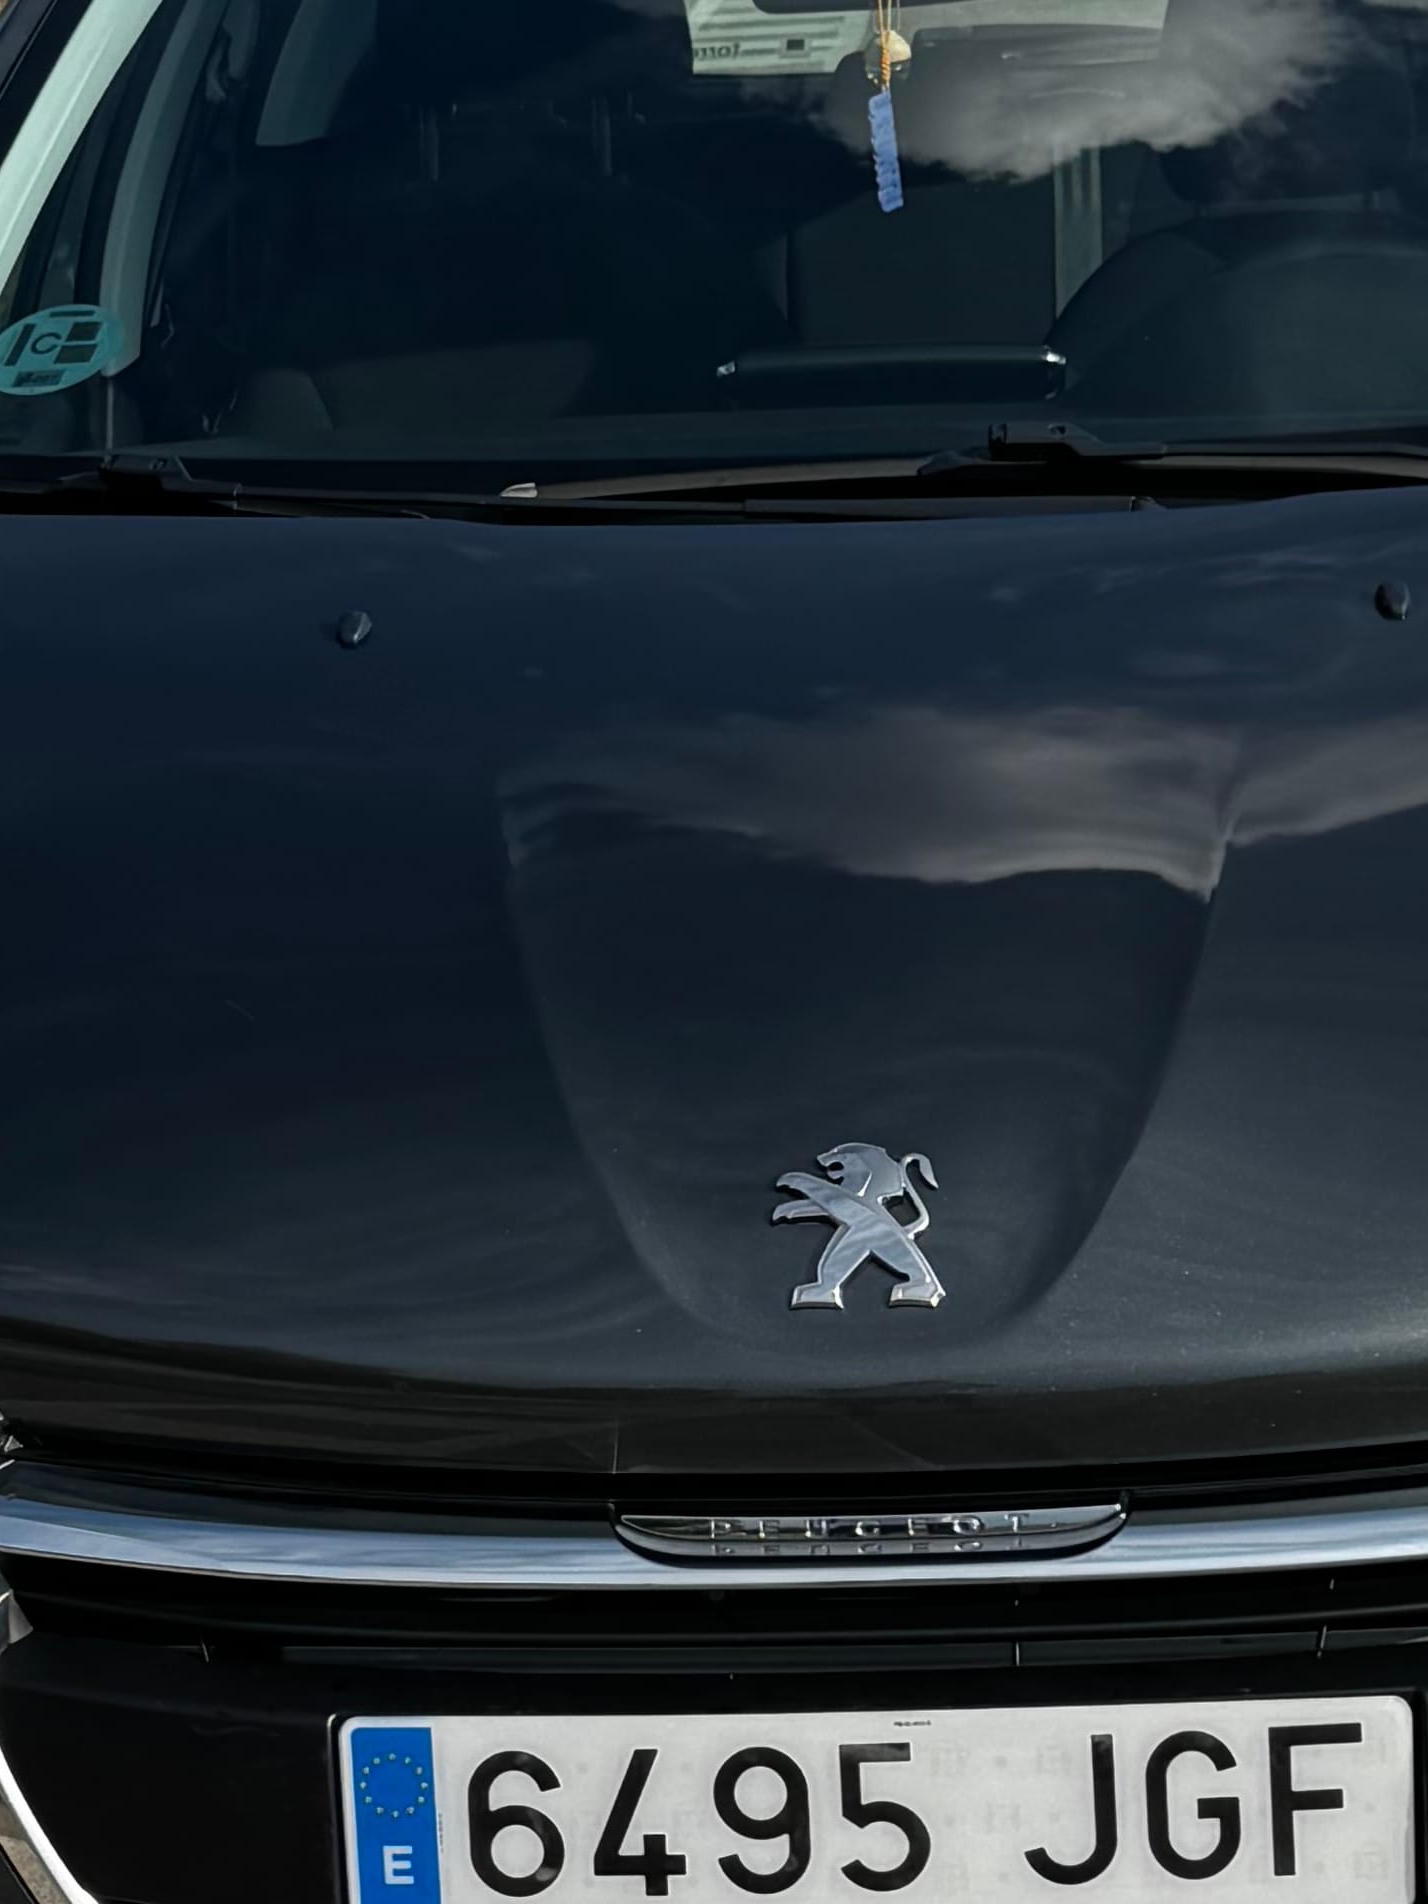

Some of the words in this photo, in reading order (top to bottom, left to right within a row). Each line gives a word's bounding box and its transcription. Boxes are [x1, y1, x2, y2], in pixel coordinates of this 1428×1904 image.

[30, 332, 62, 355] C
[710, 1512, 1029, 1539] PEUGEOT
[467, 1742, 931, 1898] 6495
[1024, 1722, 1363, 1886] JGF
[383, 1845, 414, 1885] E
